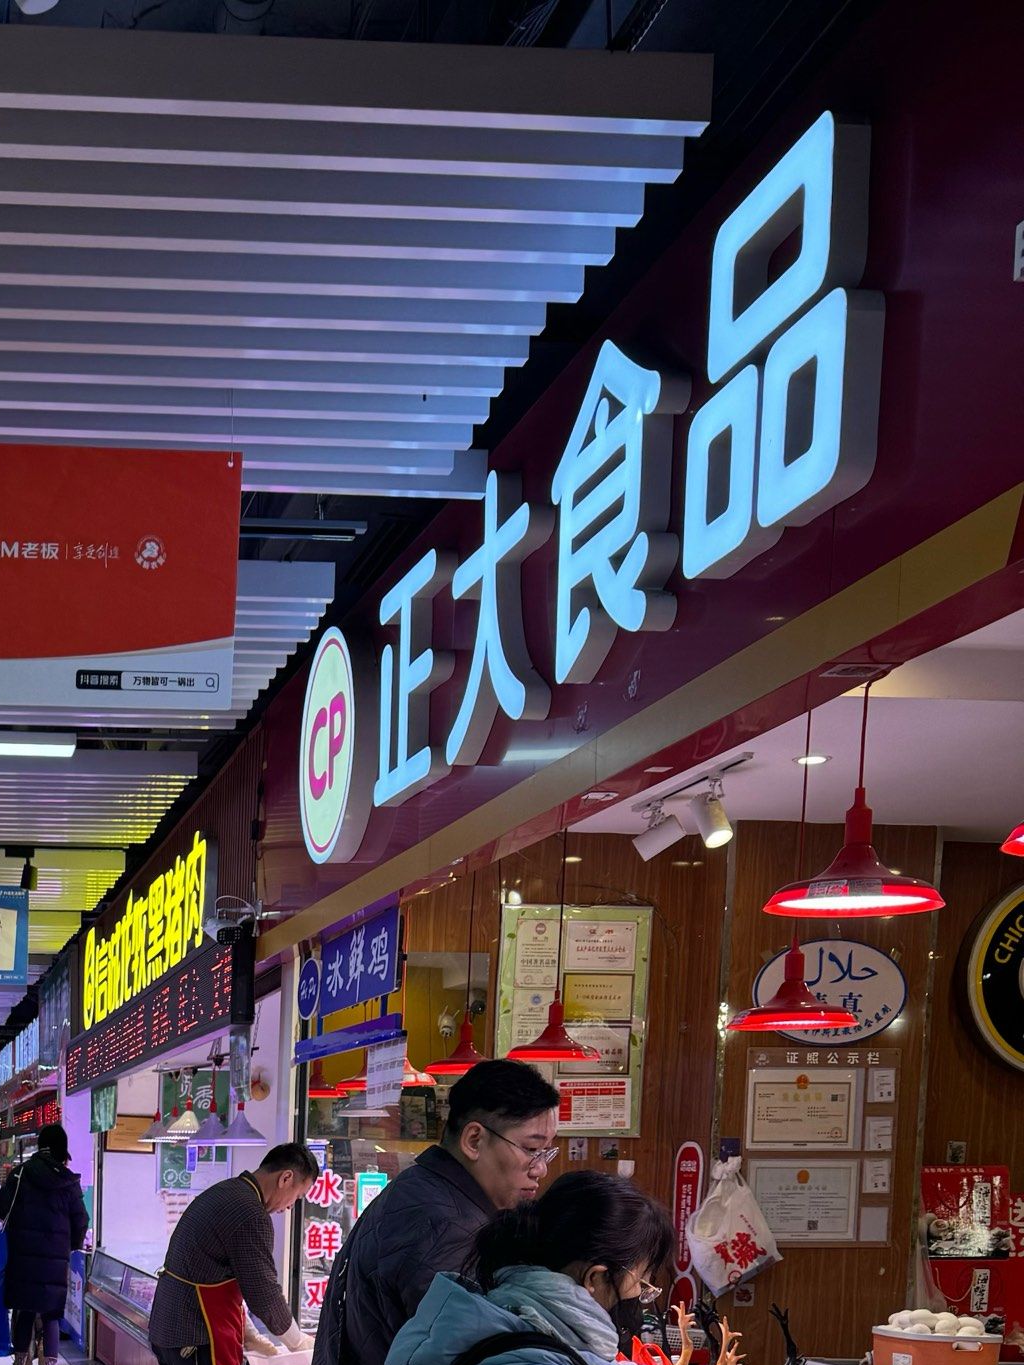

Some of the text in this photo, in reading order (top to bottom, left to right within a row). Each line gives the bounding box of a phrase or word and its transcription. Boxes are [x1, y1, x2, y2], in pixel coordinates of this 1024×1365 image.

[374, 110, 849, 807] 正大食品
[133, 676, 195, 688] 万物皆可一锅出
[308, 691, 345, 799] CP
[325, 925, 389, 1002] 冰鲜鸡
[804, 946, 879, 987] حلال
[786, 1051, 880, 1065] 证照公示栏
